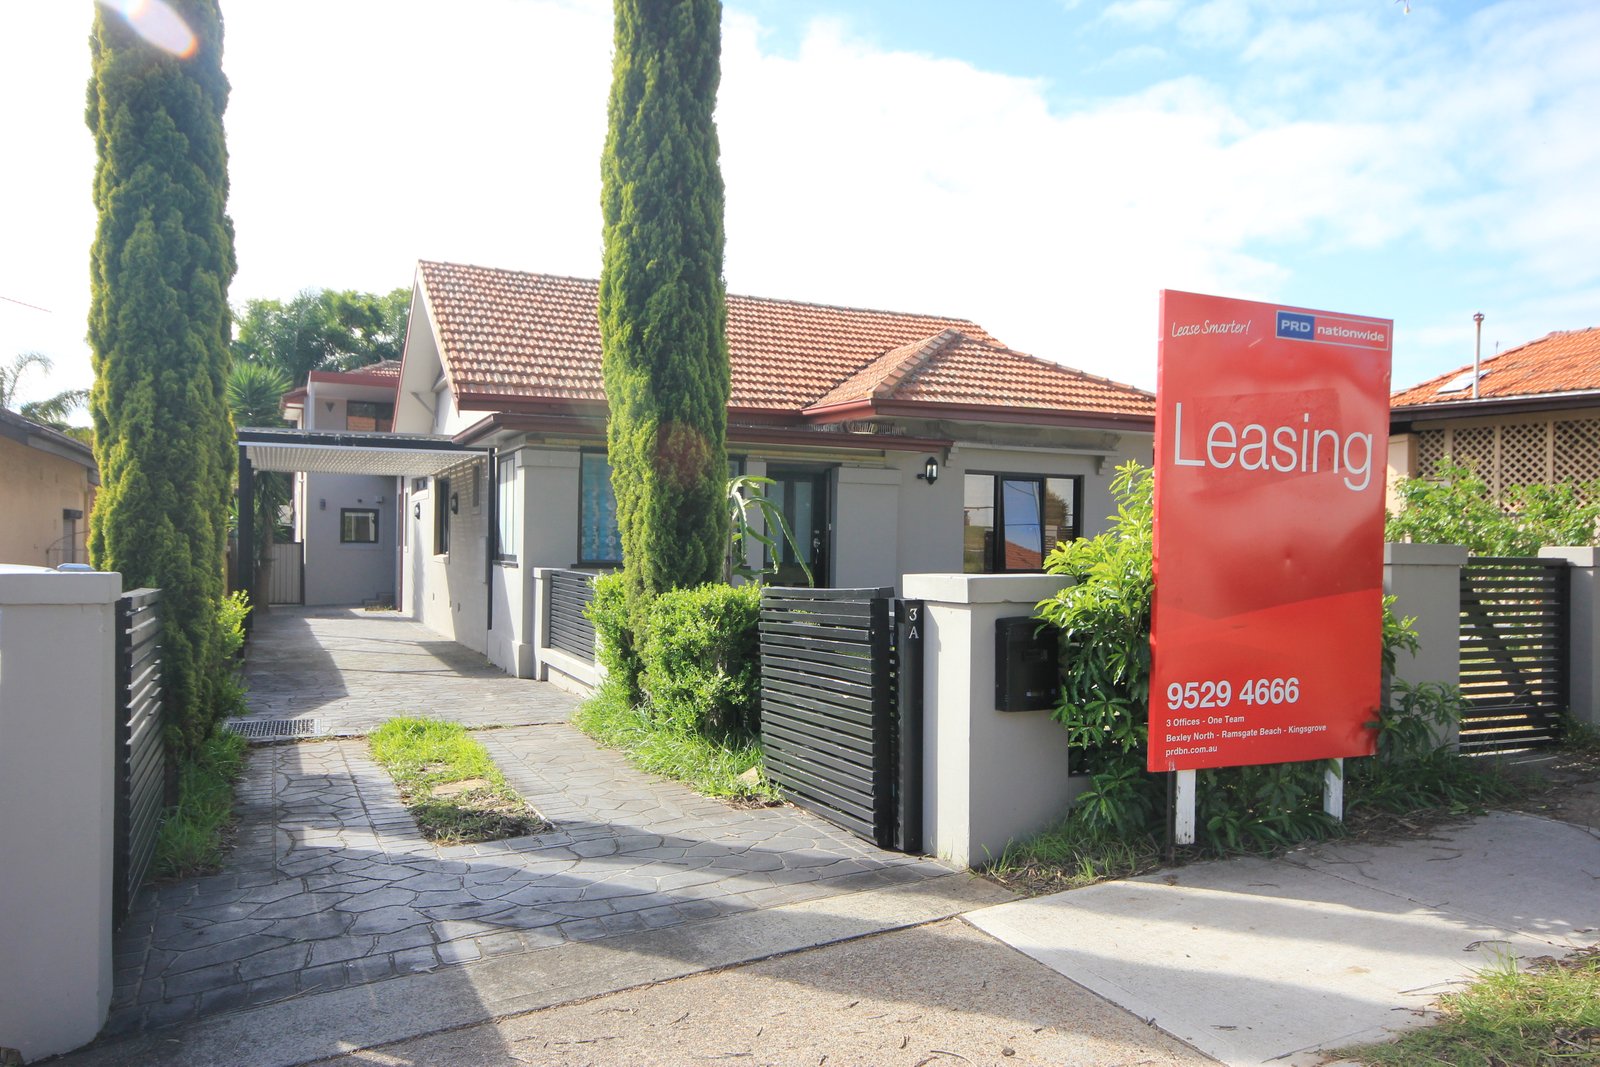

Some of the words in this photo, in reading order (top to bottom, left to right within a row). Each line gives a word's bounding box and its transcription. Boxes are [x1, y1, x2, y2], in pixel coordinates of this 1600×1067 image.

[1171, 321, 1200, 338] Lease
[1201, 319, 1252, 337] Smarter!
[1280, 319, 1311, 333] PRD
[1316, 324, 1385, 342] nationwide
[1174, 402, 1373, 493] Leasing
[1166, 680, 1232, 711] 9529
[1238, 677, 1299, 706] 4666
[1173, 718, 1200, 727] Offices
[1207, 717, 1223, 725] One
[1225, 715, 1245, 724] Team
[1166, 733, 1192, 743] Bexley
[1193, 732, 1215, 740] North
[1221, 729, 1258, 739] Ramsgate
[1259, 727, 1282, 736] Beach
[1288, 724, 1327, 734] Kingsgrove
[1165, 745, 1218, 758] prdbn.com.au
